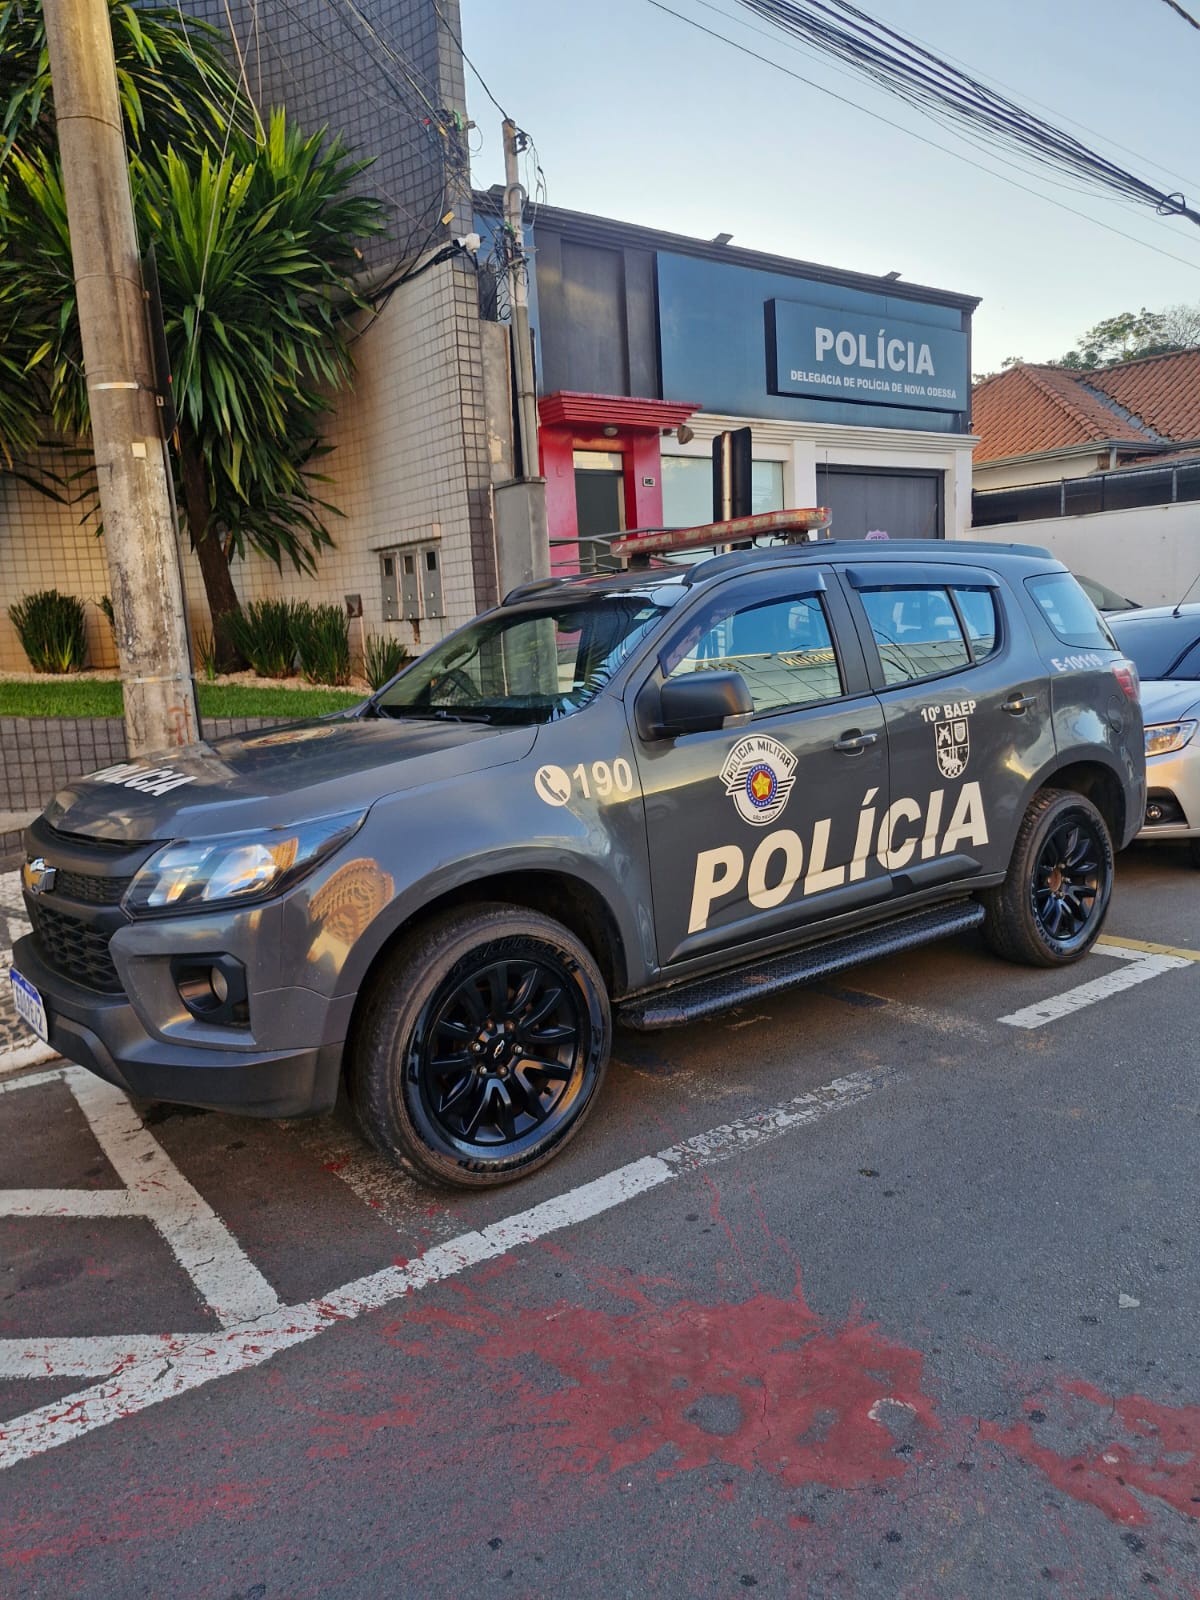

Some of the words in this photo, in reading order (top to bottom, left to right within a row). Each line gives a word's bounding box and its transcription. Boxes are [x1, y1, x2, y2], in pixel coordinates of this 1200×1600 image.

[815, 326, 935, 377] POLÍCIA
[790, 370, 842, 387] DELEGACIA
[843, 377, 856, 388] DE
[856, 378, 890, 392] POLÍCIA
[891, 383, 903, 393] DE
[904, 384, 926, 396] NOVA
[926, 387, 957, 399] ODESSA
[943, 700, 977, 719] BAEP
[757, 740, 792, 768] MILITAR
[573, 758, 633, 799] 190
[688, 781, 989, 935] POLÍCIA
